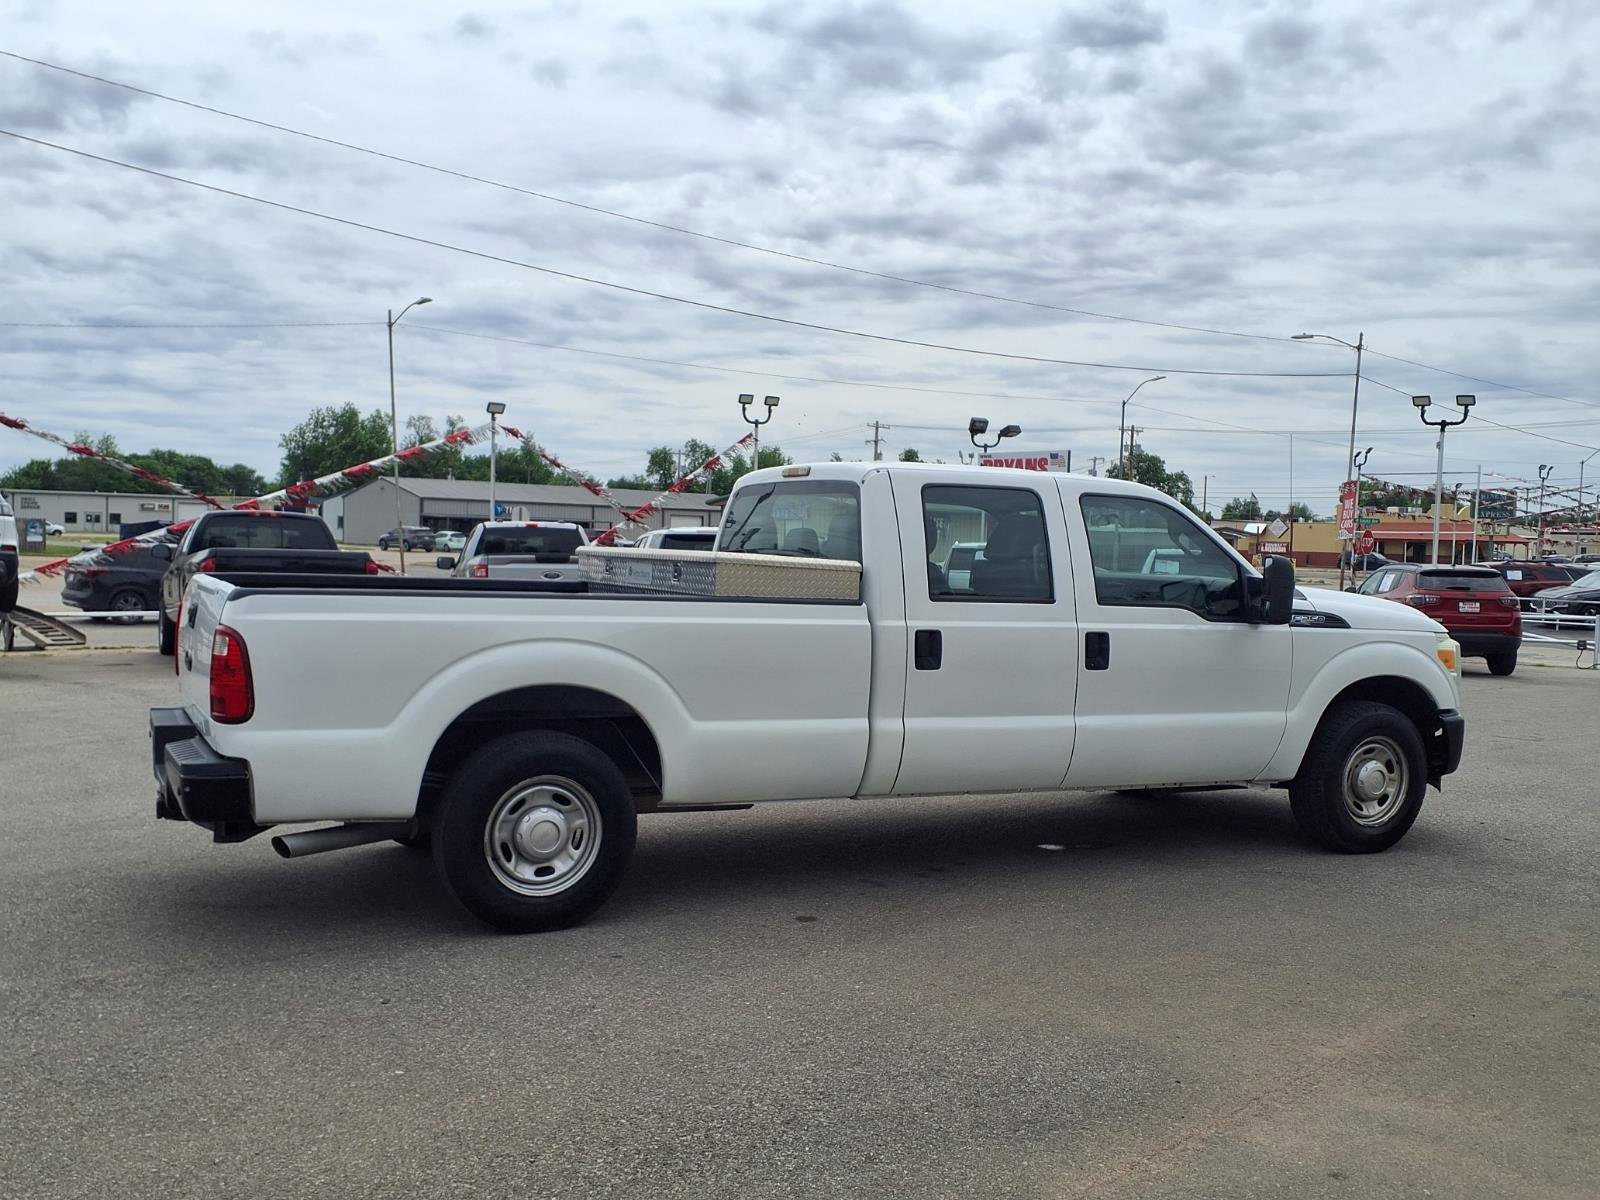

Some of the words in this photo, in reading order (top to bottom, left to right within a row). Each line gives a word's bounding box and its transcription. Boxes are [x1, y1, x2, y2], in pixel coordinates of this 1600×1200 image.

[1344, 498, 1354, 509] WE
[1343, 509, 1354, 519] BUY
[1340, 519, 1354, 529] CARS
[1362, 537, 1373, 547] STOP
